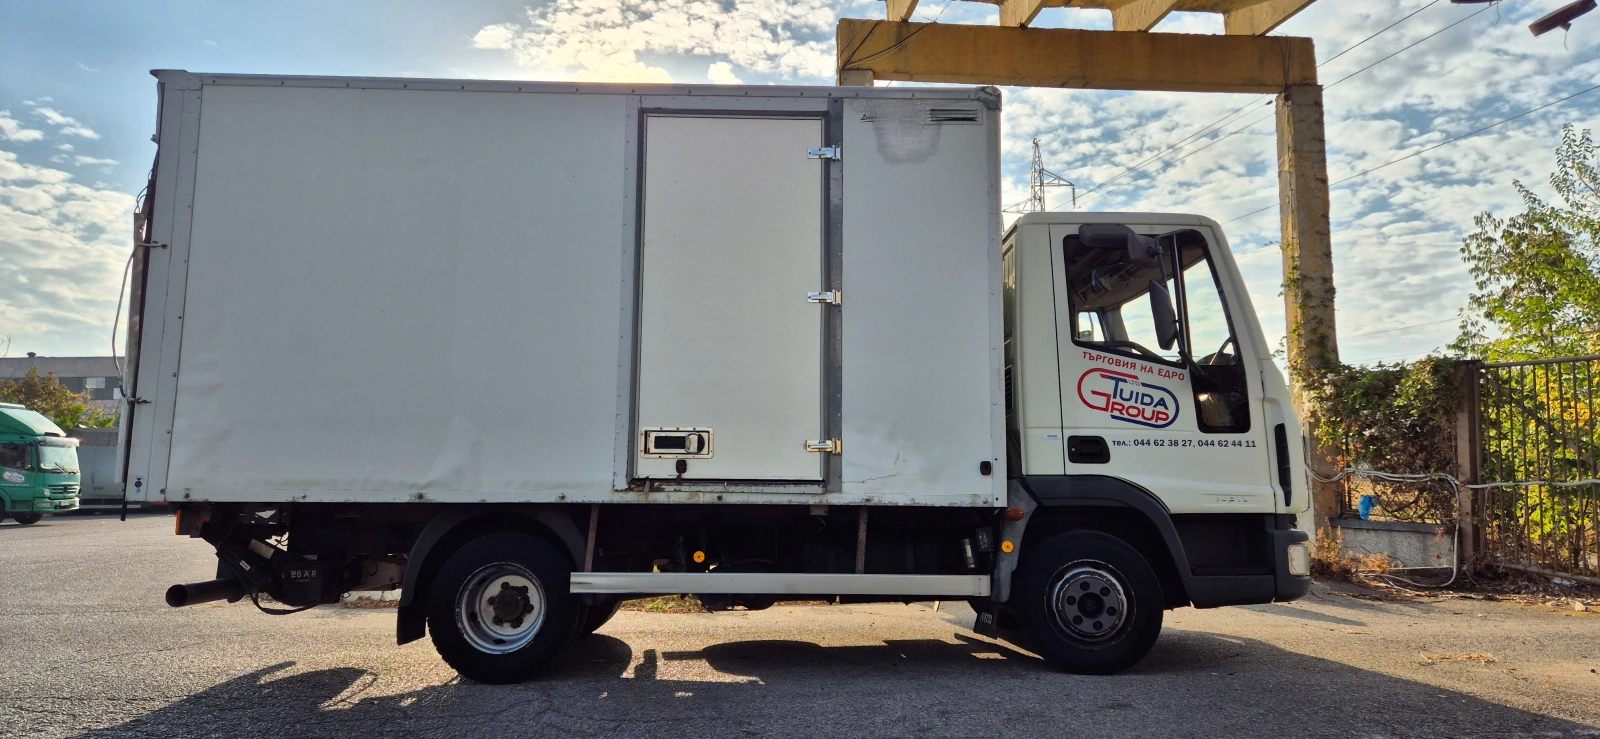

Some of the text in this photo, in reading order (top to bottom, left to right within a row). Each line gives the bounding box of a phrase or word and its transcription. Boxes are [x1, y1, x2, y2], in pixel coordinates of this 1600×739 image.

[1082, 351, 1185, 381] ТЪРГОВИЯ НА ЕДРО
[1100, 373, 1169, 410] TUIDA
[1112, 439, 1257, 448] тел.: 044 62 38 27, 044 62 44 11
